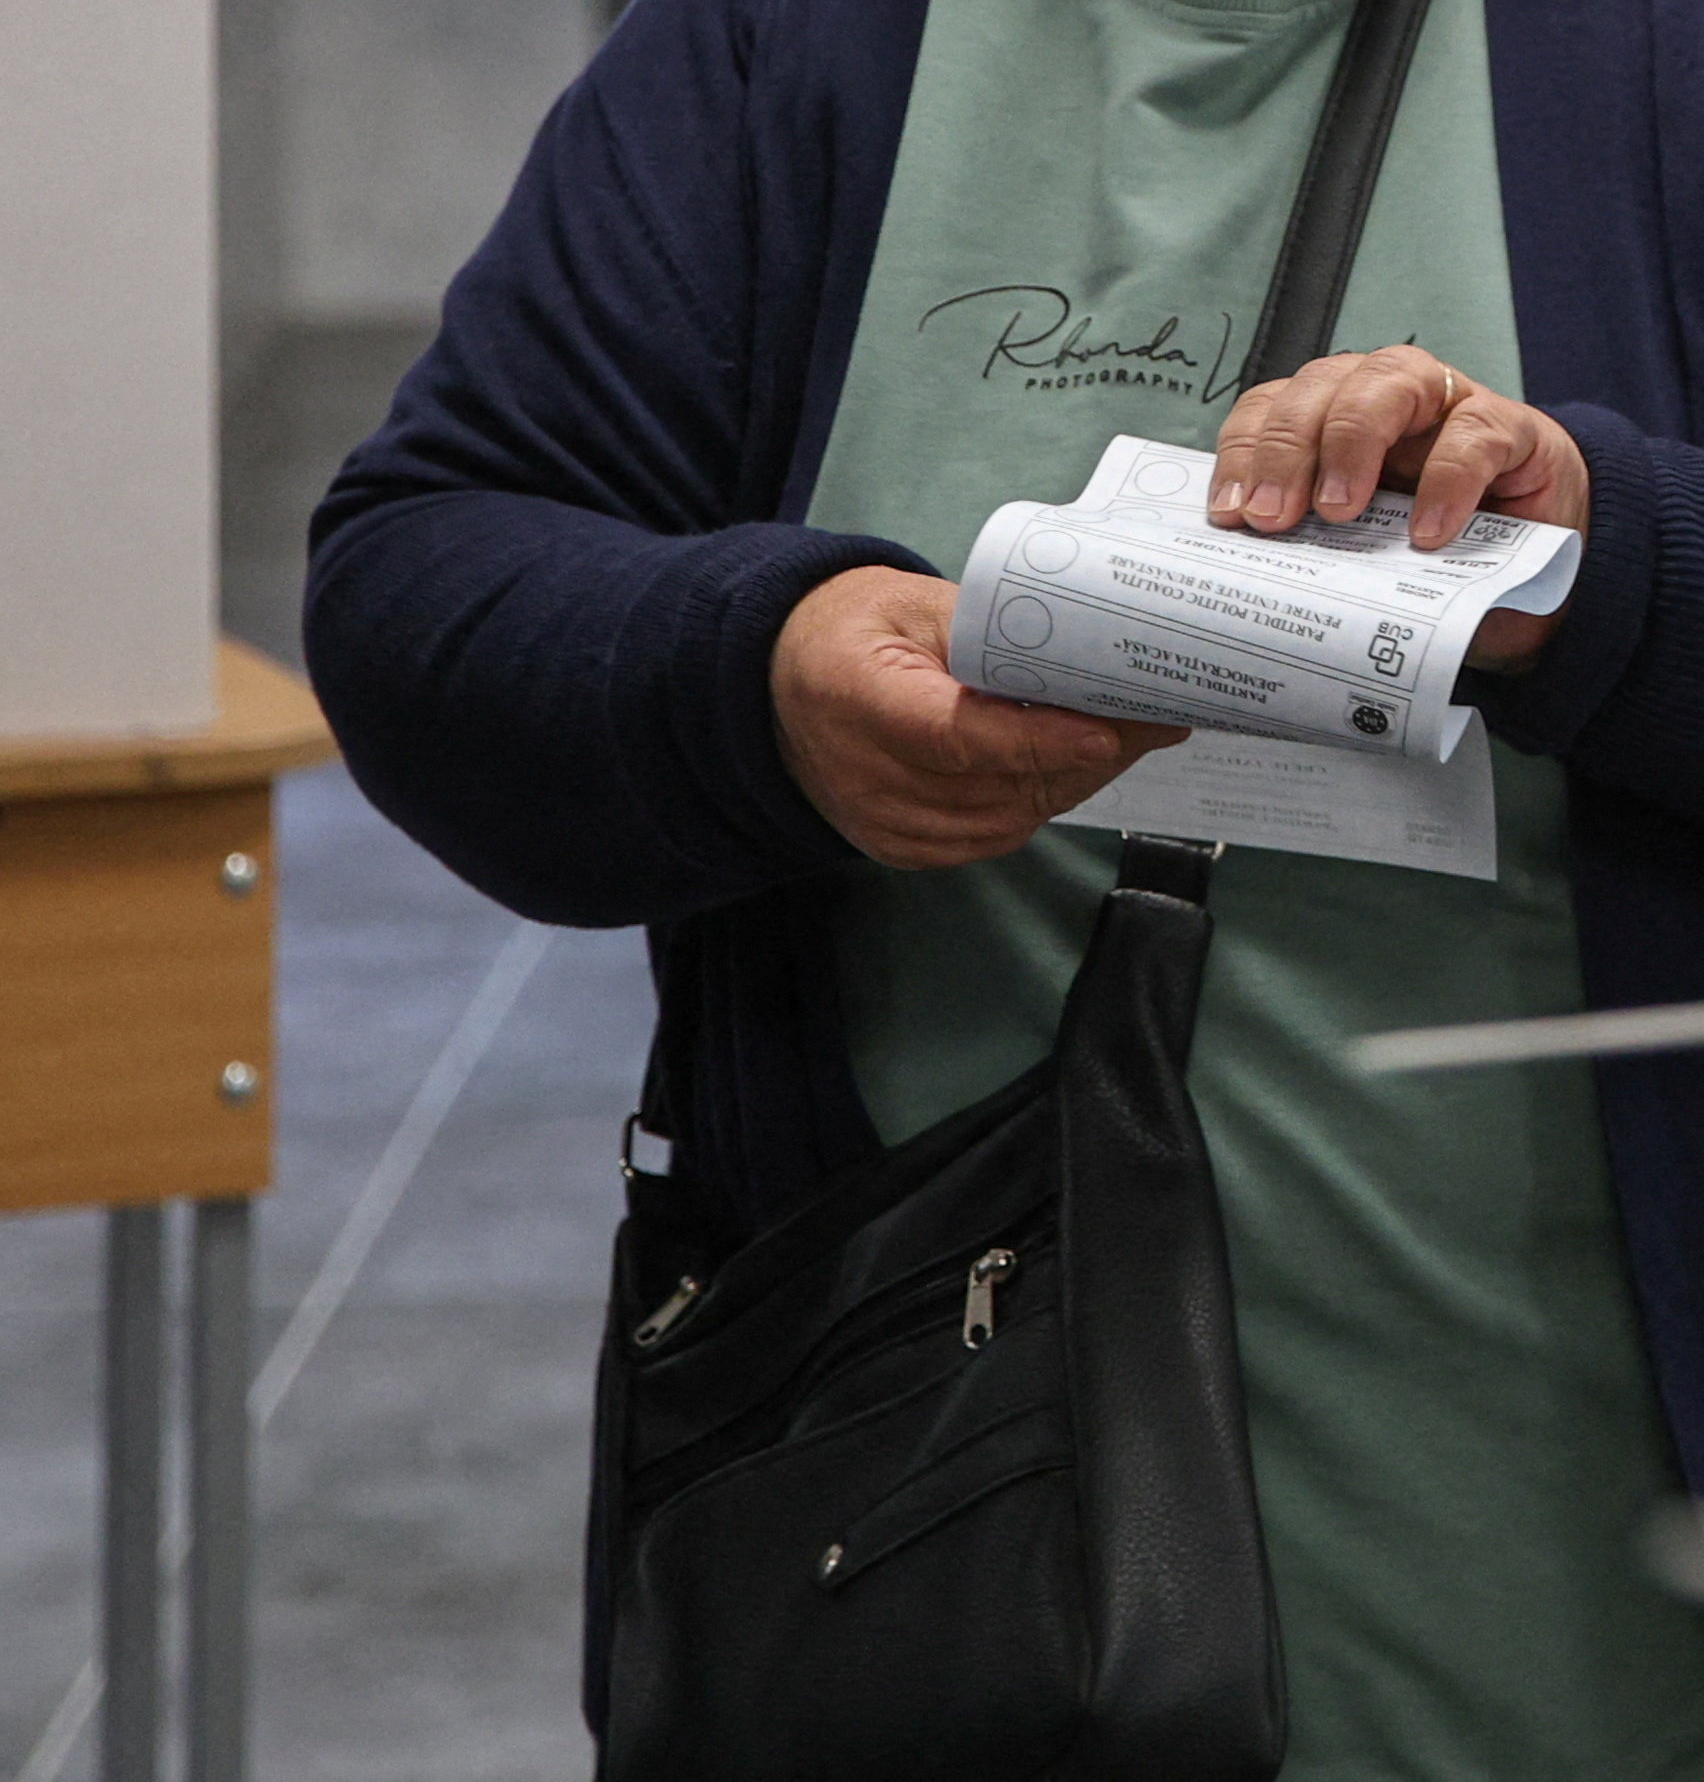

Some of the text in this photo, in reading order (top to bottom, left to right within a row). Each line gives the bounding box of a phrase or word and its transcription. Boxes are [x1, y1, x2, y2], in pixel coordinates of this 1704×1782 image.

[918, 284, 1198, 379] Rhonda
[1024, 367, 1194, 396] PHOTOGRAPHY
[1107, 554, 1195, 587] BUNĂSTARE
[1112, 570, 1326, 644] PARTIDUL POLITIC COALIȚIA
[1217, 585, 1279, 610] UNITATE
[1282, 603, 1343, 630] PENTRU
[1378, 621, 1414, 641] CUB
[1126, 657, 1268, 705] PARTIDUL POLITIC
